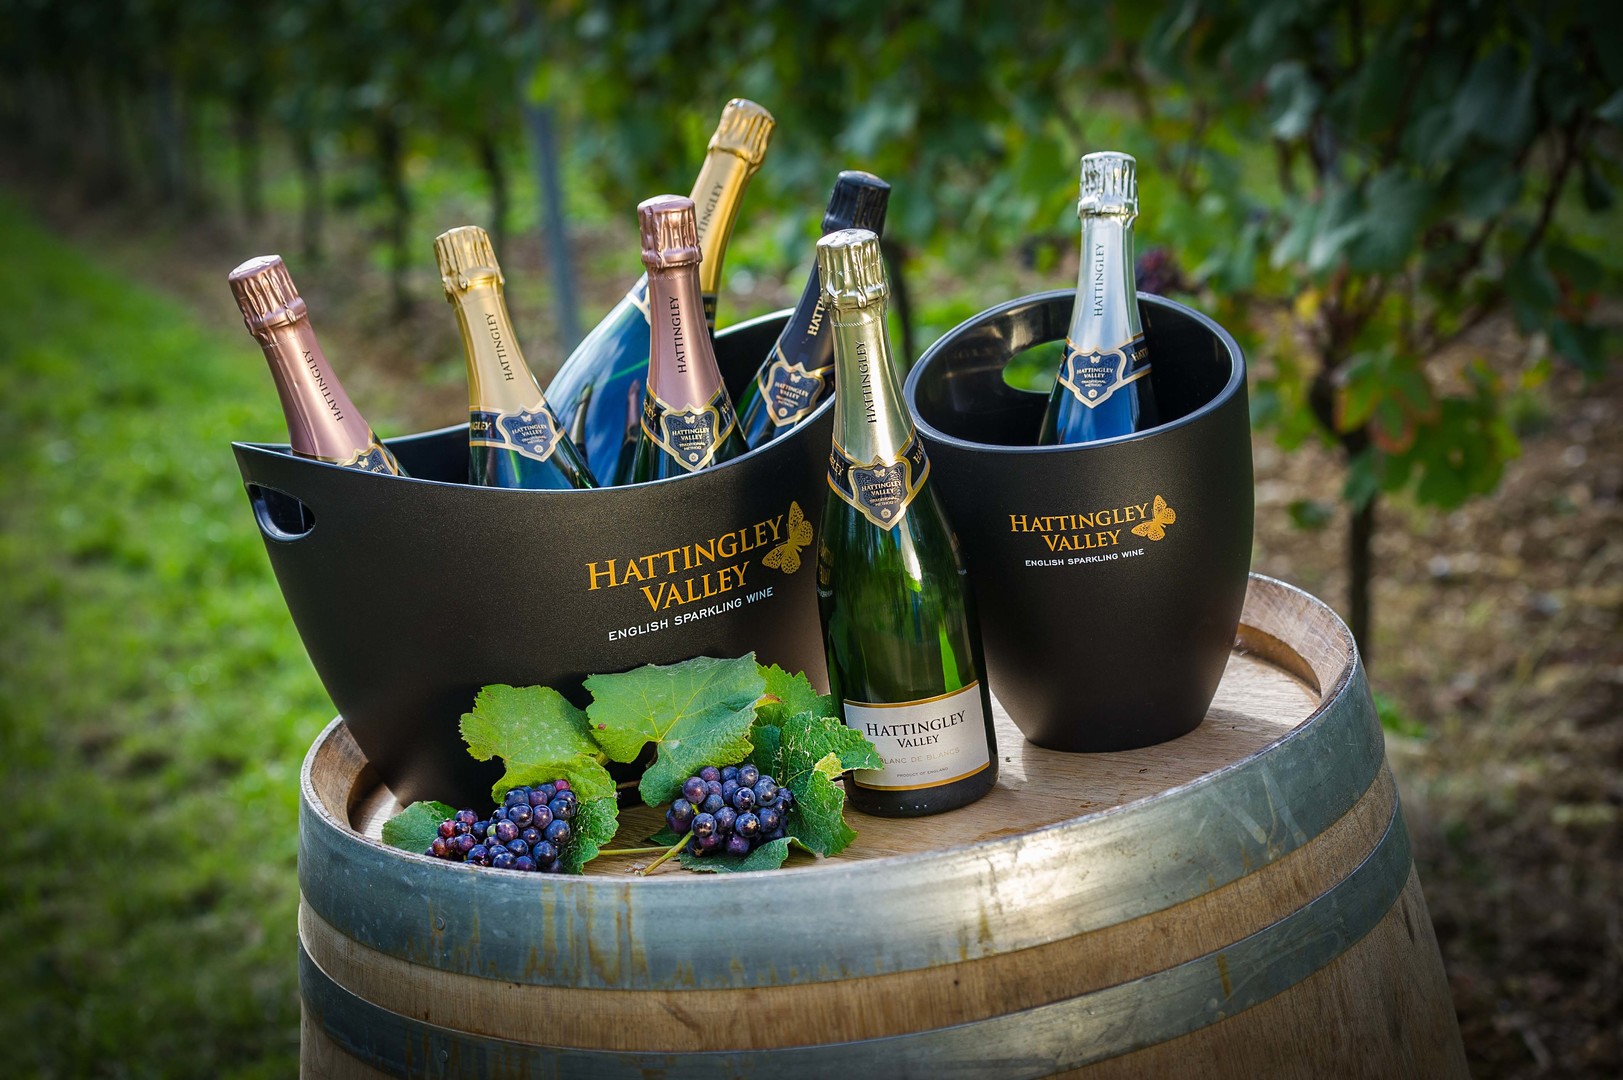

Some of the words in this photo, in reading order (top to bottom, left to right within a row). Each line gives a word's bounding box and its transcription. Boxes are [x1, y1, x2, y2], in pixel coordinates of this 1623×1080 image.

[1093, 243, 1105, 317] HATTINGLEY
[669, 296, 687, 374] HATTINGLEY
[485, 312, 514, 382] HATTINGLEY
[1076, 367, 1114, 375] HATTINGLEY
[302, 350, 343, 421] HATTINGLEY
[774, 381, 809, 398] HATTINGLEY
[855, 340, 877, 423] HATTINGLEY
[512, 424, 547, 435] HATTINGLEY
[672, 427, 710, 436] HATTINGLEY
[681, 433, 703, 441] VALLEY
[861, 480, 902, 492] HATTINGLEY
[870, 487, 895, 497] VALLEY
[1009, 502, 1149, 532] HATTINGLEY
[1041, 529, 1121, 552] VALLEY
[585, 514, 783, 591] HATTINGLEY
[1025, 559, 1065, 567] ENGLISH
[1068, 553, 1118, 565] SPARKLING
[1121, 549, 1144, 558] WINE
[639, 561, 750, 612] VALLEY
[608, 618, 670, 642] ENGLISH
[674, 597, 743, 626] SPARKLING
[746, 587, 773, 603] WINE
[866, 710, 965, 736] HATTINGLEY
[896, 734, 940, 749] VALLEY
[910, 755, 923, 763] DE
[926, 747, 960, 760] BLANCS
[927, 766, 949, 775] ENGLAND
